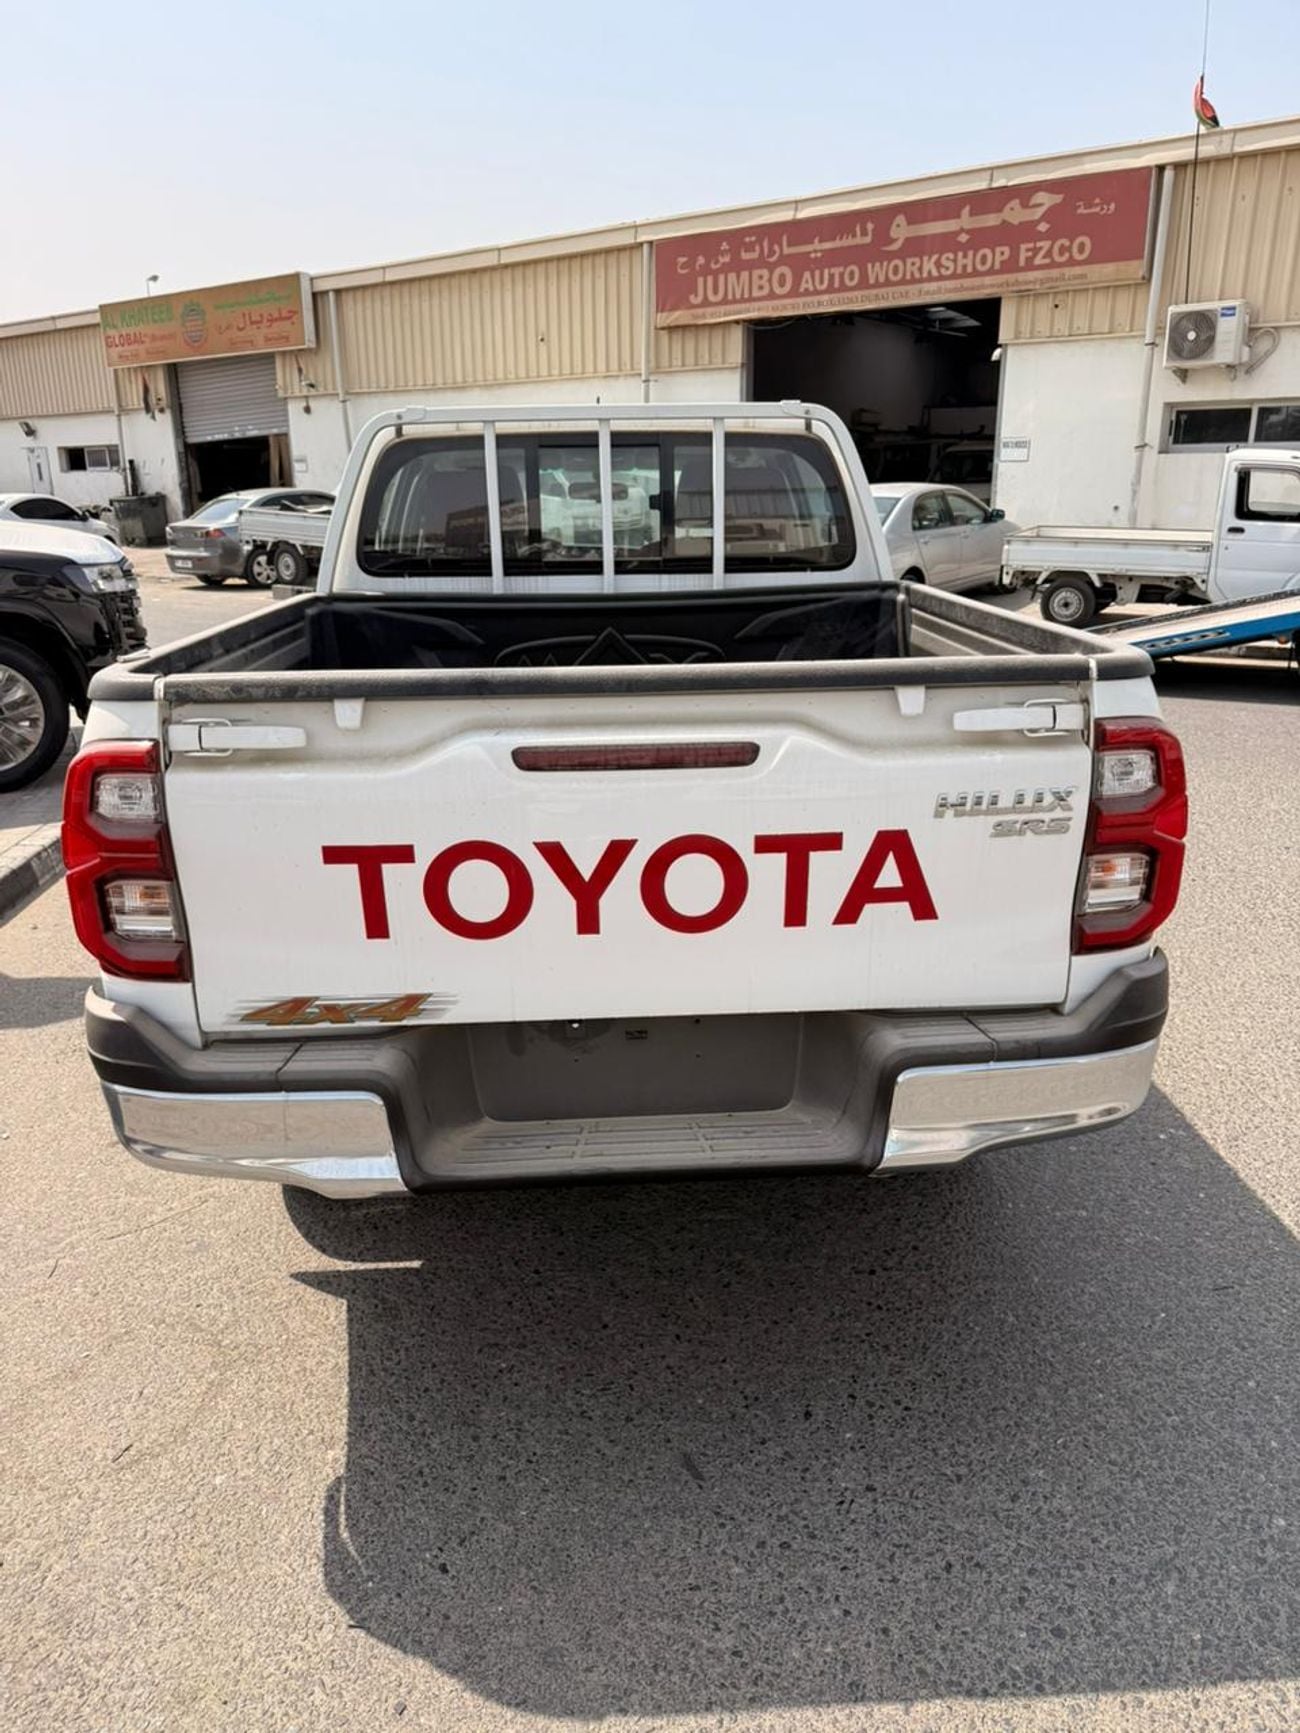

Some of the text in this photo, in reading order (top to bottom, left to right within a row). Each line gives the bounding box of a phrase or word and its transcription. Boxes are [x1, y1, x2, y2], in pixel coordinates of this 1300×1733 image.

[881, 191, 1065, 251] جمبو
[1075, 198, 1115, 215] ورشة
[740, 219, 875, 263] للسيارات
[689, 235, 1092, 305] JUMBO AUTO WORKSHOP FZCO
[101, 311, 117, 331] AL
[105, 332, 146, 348] GLOBAL
[934, 786, 1077, 819] HILUX
[321, 829, 940, 941] TOYOTA
